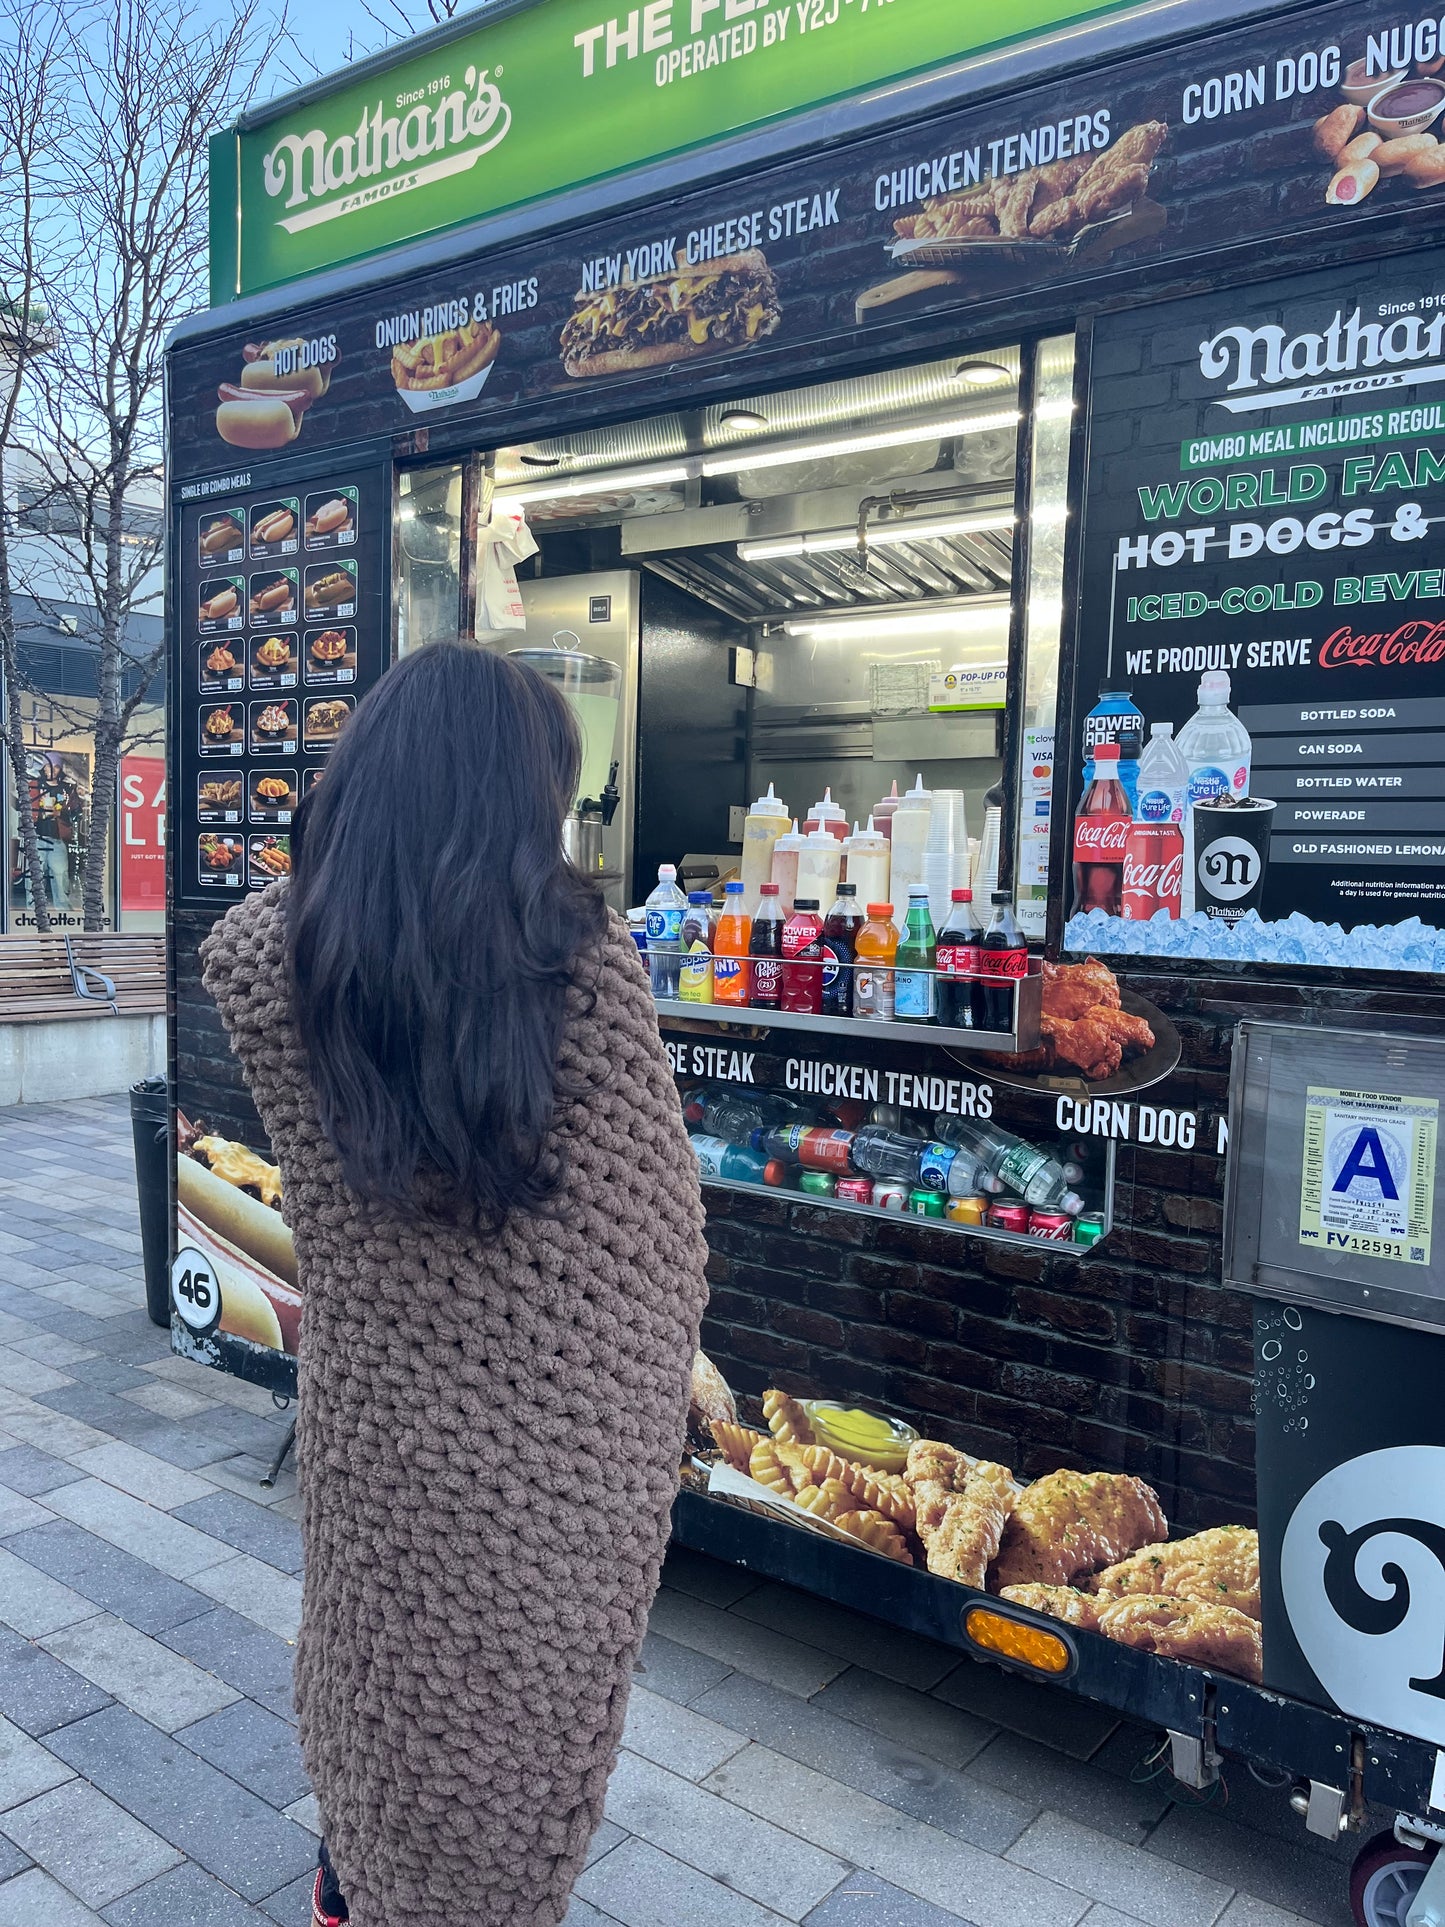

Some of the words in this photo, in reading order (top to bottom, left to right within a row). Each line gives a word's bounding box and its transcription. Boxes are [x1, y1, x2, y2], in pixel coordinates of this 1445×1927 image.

[574, 0, 673, 77] THE
[655, 20, 757, 87] OPERATED
[763, 6, 791, 48] BY
[396, 86, 425, 109] Since
[427, 75, 451, 97] 1916
[1182, 64, 1266, 124] CORN
[1275, 45, 1341, 100] DOG
[263, 65, 505, 209] Nathan's
[874, 146, 981, 212] CHICKEN
[987, 109, 1110, 178] TENDERS
[340, 174, 419, 212] FAMOUS
[581, 254, 621, 293] NEW
[625, 236, 677, 282] YORK
[685, 211, 762, 264] CHEESE
[767, 188, 840, 241] STEAK
[375, 311, 420, 349] ONION
[423, 297, 469, 336] RINGS
[473, 292, 487, 323] &
[492, 277, 539, 318] FRIES
[1378, 302, 1416, 316] Since
[273, 344, 299, 376] HOT
[301, 335, 337, 368] DOGS
[1300, 374, 1407, 399] FAMOUS
[1189, 434, 1246, 465] COMBO
[1249, 428, 1294, 456] MEAL
[1299, 415, 1383, 448] INCLUDES
[181, 483, 201, 499] SINGLE
[201, 481, 210, 495] OR
[209, 477, 231, 493] COMBO
[230, 473, 251, 489] MEALS
[1137, 464, 1327, 521] WORLD
[1117, 526, 1216, 571] HOT
[1228, 508, 1374, 559] DOGS
[1390, 503, 1429, 542] &
[1127, 580, 1323, 622] ICED-COLD
[1334, 569, 1445, 606] BEVE
[1126, 650, 1153, 675] WE
[1156, 643, 1243, 674] PRODULY
[1246, 638, 1313, 668] SERVE
[1318, 620, 1445, 668] Coca-Cola
[960, 673, 993, 682] POP-UP
[1086, 715, 1141, 732] POWER
[1300, 709, 1357, 720] BOTTLED
[1359, 708, 1396, 719] SODA
[1086, 731, 1116, 746] ADE
[1299, 745, 1325, 754] CAN
[1327, 744, 1363, 754] SODA
[1031, 752, 1053, 760] VISA
[1188, 784, 1210, 794] Pure
[1211, 784, 1229, 795] Life
[1296, 778, 1352, 787] BOTTLED
[1356, 777, 1402, 787] WATER
[1141, 803, 1157, 811] Pure
[1157, 803, 1171, 811] Life
[1294, 811, 1366, 820] POWERADE
[1293, 844, 1317, 854] OLD
[1320, 844, 1392, 854] FASHIONED
[1330, 880, 1364, 888] Additional
[1365, 880, 1394, 888] nutrition
[1394, 881, 1435, 890] information
[1345, 889, 1357, 898] day
[1393, 890, 1420, 899] general
[1206, 905, 1246, 917] Nathan's
[783, 926, 817, 937] POWER
[692, 1045, 756, 1084] STEAK
[785, 1058, 879, 1102] CHICKEN
[884, 1070, 993, 1119] TENDERS
[1056, 1095, 1131, 1140] CORN
[1138, 1105, 1197, 1149] DOG
[1339, 1090, 1361, 1099] MOBILE
[1362, 1092, 1378, 1100] FOOD
[1379, 1093, 1402, 1102] VENDOR
[1355, 1101, 1399, 1111] TRANSFERABLE
[1334, 1112, 1357, 1120] SANITARY
[1358, 1115, 1388, 1124] INSPECTION
[1331, 1126, 1400, 1201] A
[1301, 1229, 1319, 1238] NYC
[1326, 1231, 1402, 1257] FV12591
[178, 1269, 212, 1309] 46
